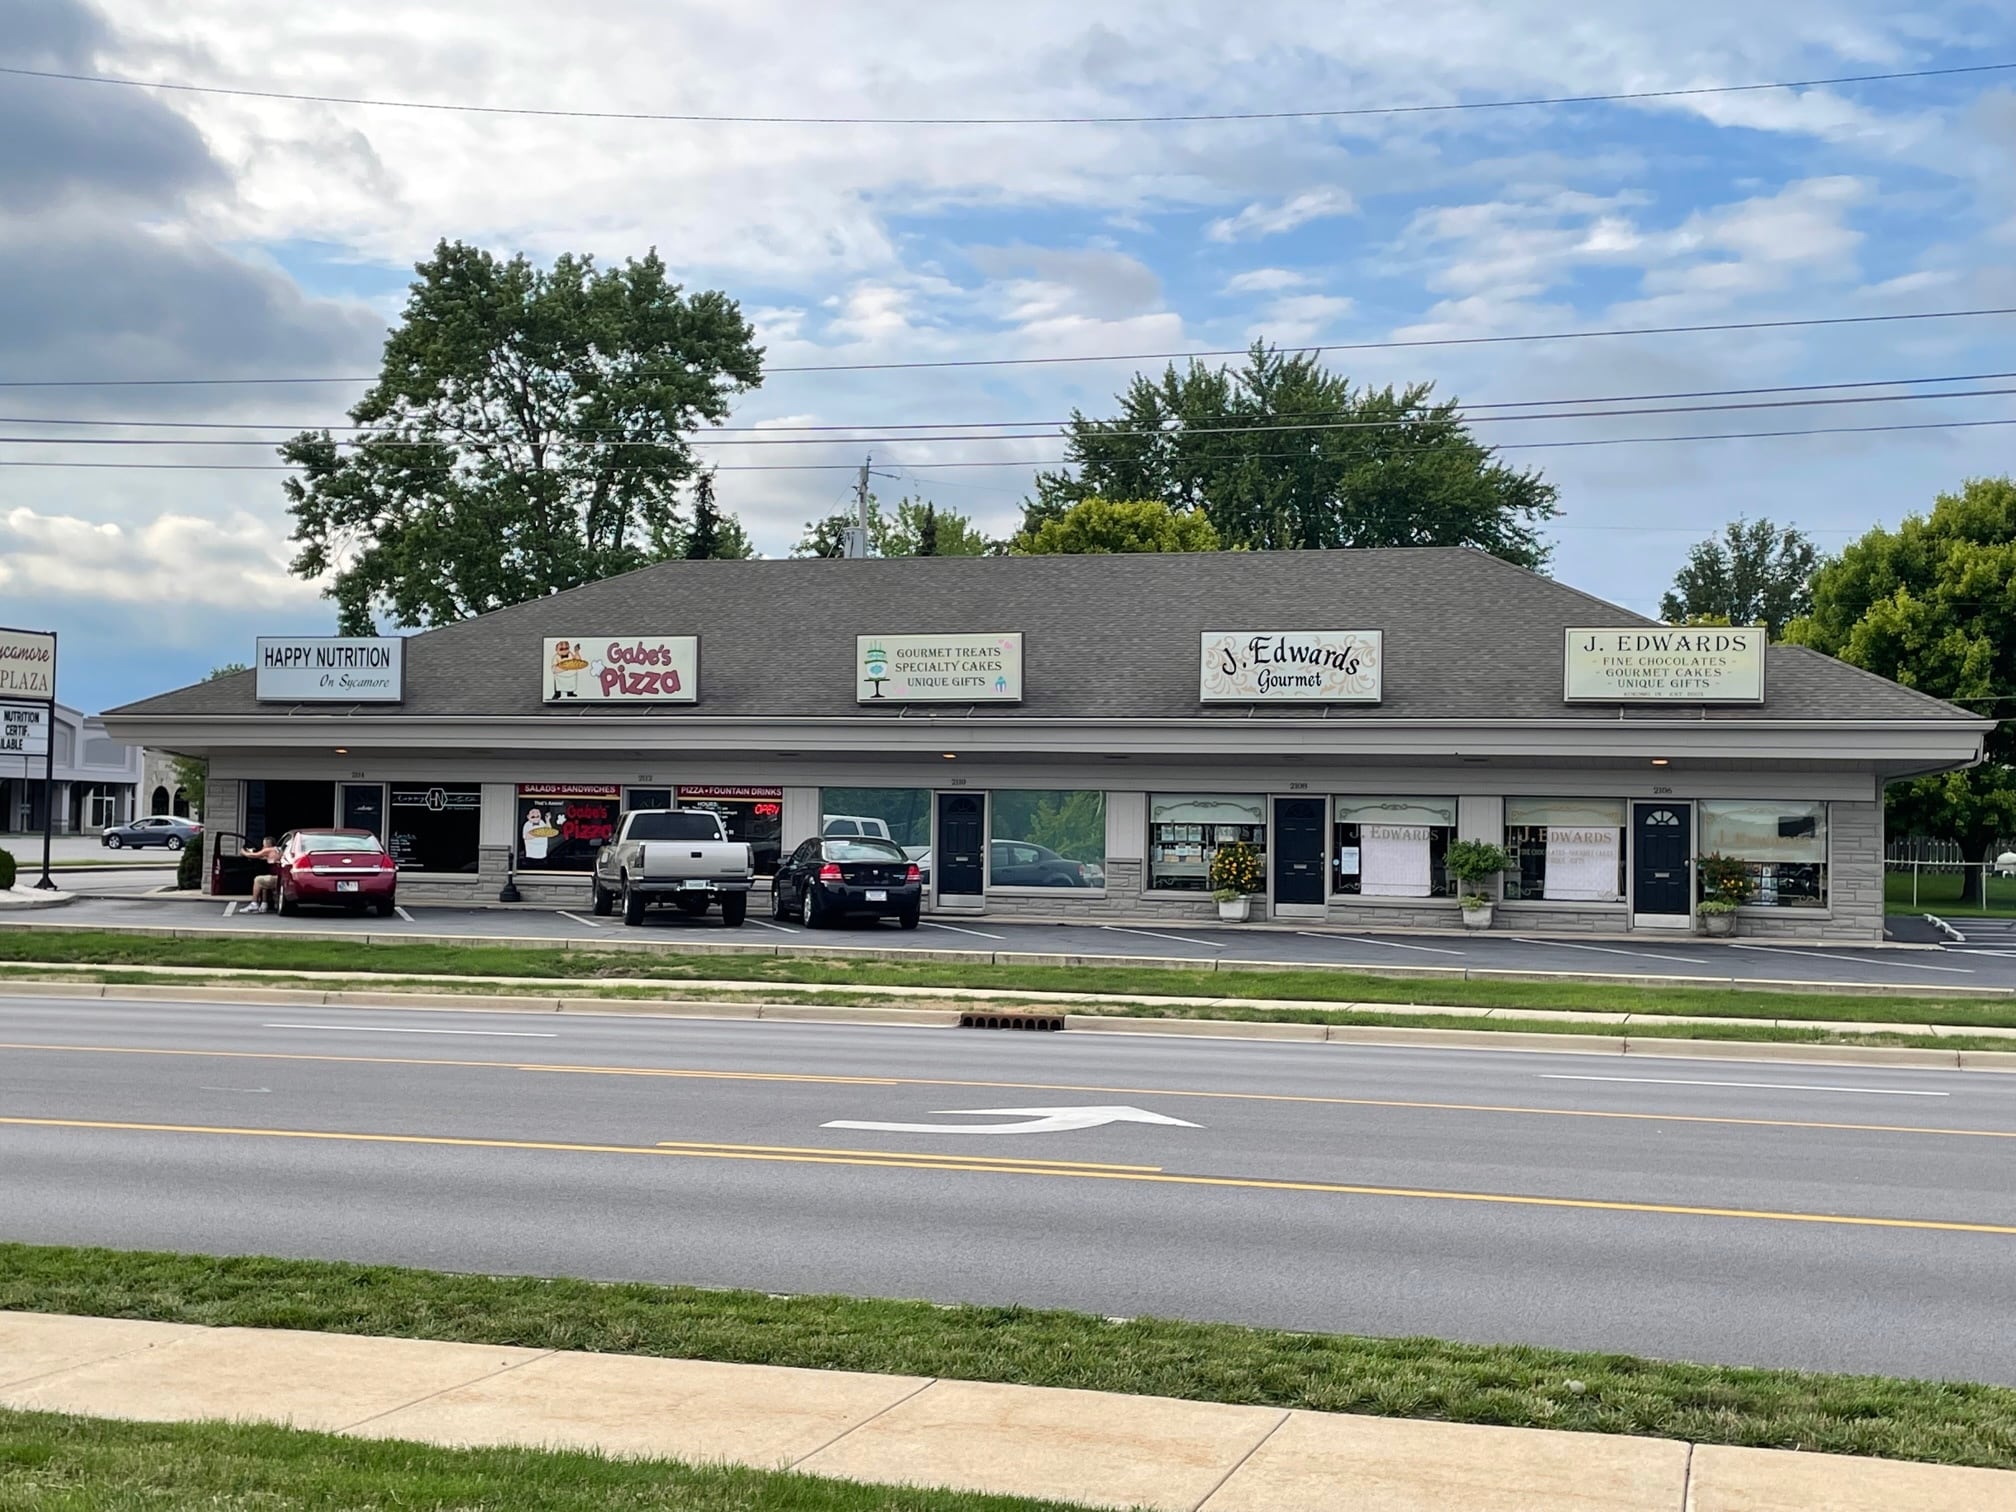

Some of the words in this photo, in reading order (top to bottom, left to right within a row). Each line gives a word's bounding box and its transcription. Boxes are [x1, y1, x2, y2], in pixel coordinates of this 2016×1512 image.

[1584, 636, 1604, 652] J.
[1618, 633, 1746, 652] EDWARDS
[264, 647, 312, 668] HAPPY
[316, 647, 390, 668] NUTRITION
[606, 641, 671, 666] Gabe's
[896, 648, 952, 658] GOURMET
[955, 647, 1001, 657] TREATS
[1222, 648, 1246, 676] J.
[1250, 636, 1360, 676] Edwards
[895, 661, 960, 672] SPECIALTY
[962, 661, 1002, 672] CAKES
[1603, 656, 1633, 666] FINE
[1638, 656, 1727, 666] CHOCOLATES
[1605, 668, 1670, 677] GOURMET
[1675, 668, 1722, 677] CAKES
[0, 670, 48, 691] PLAZA
[320, 674, 334, 688] On
[338, 674, 390, 691] Sycamore
[600, 664, 681, 697] Pizza
[907, 677, 950, 687] UNIQUE
[952, 676, 986, 687] GIFTS
[1258, 668, 1322, 694] Gourmet
[1618, 679, 1664, 688] UNIQUE
[1670, 679, 1710, 688] GIFTS
[4, 710, 40, 722] NUTRITION
[562, 785, 616, 794] SANDWICHES
[708, 787, 749, 795] FOUNTAIN
[751, 788, 782, 796] DRINKS
